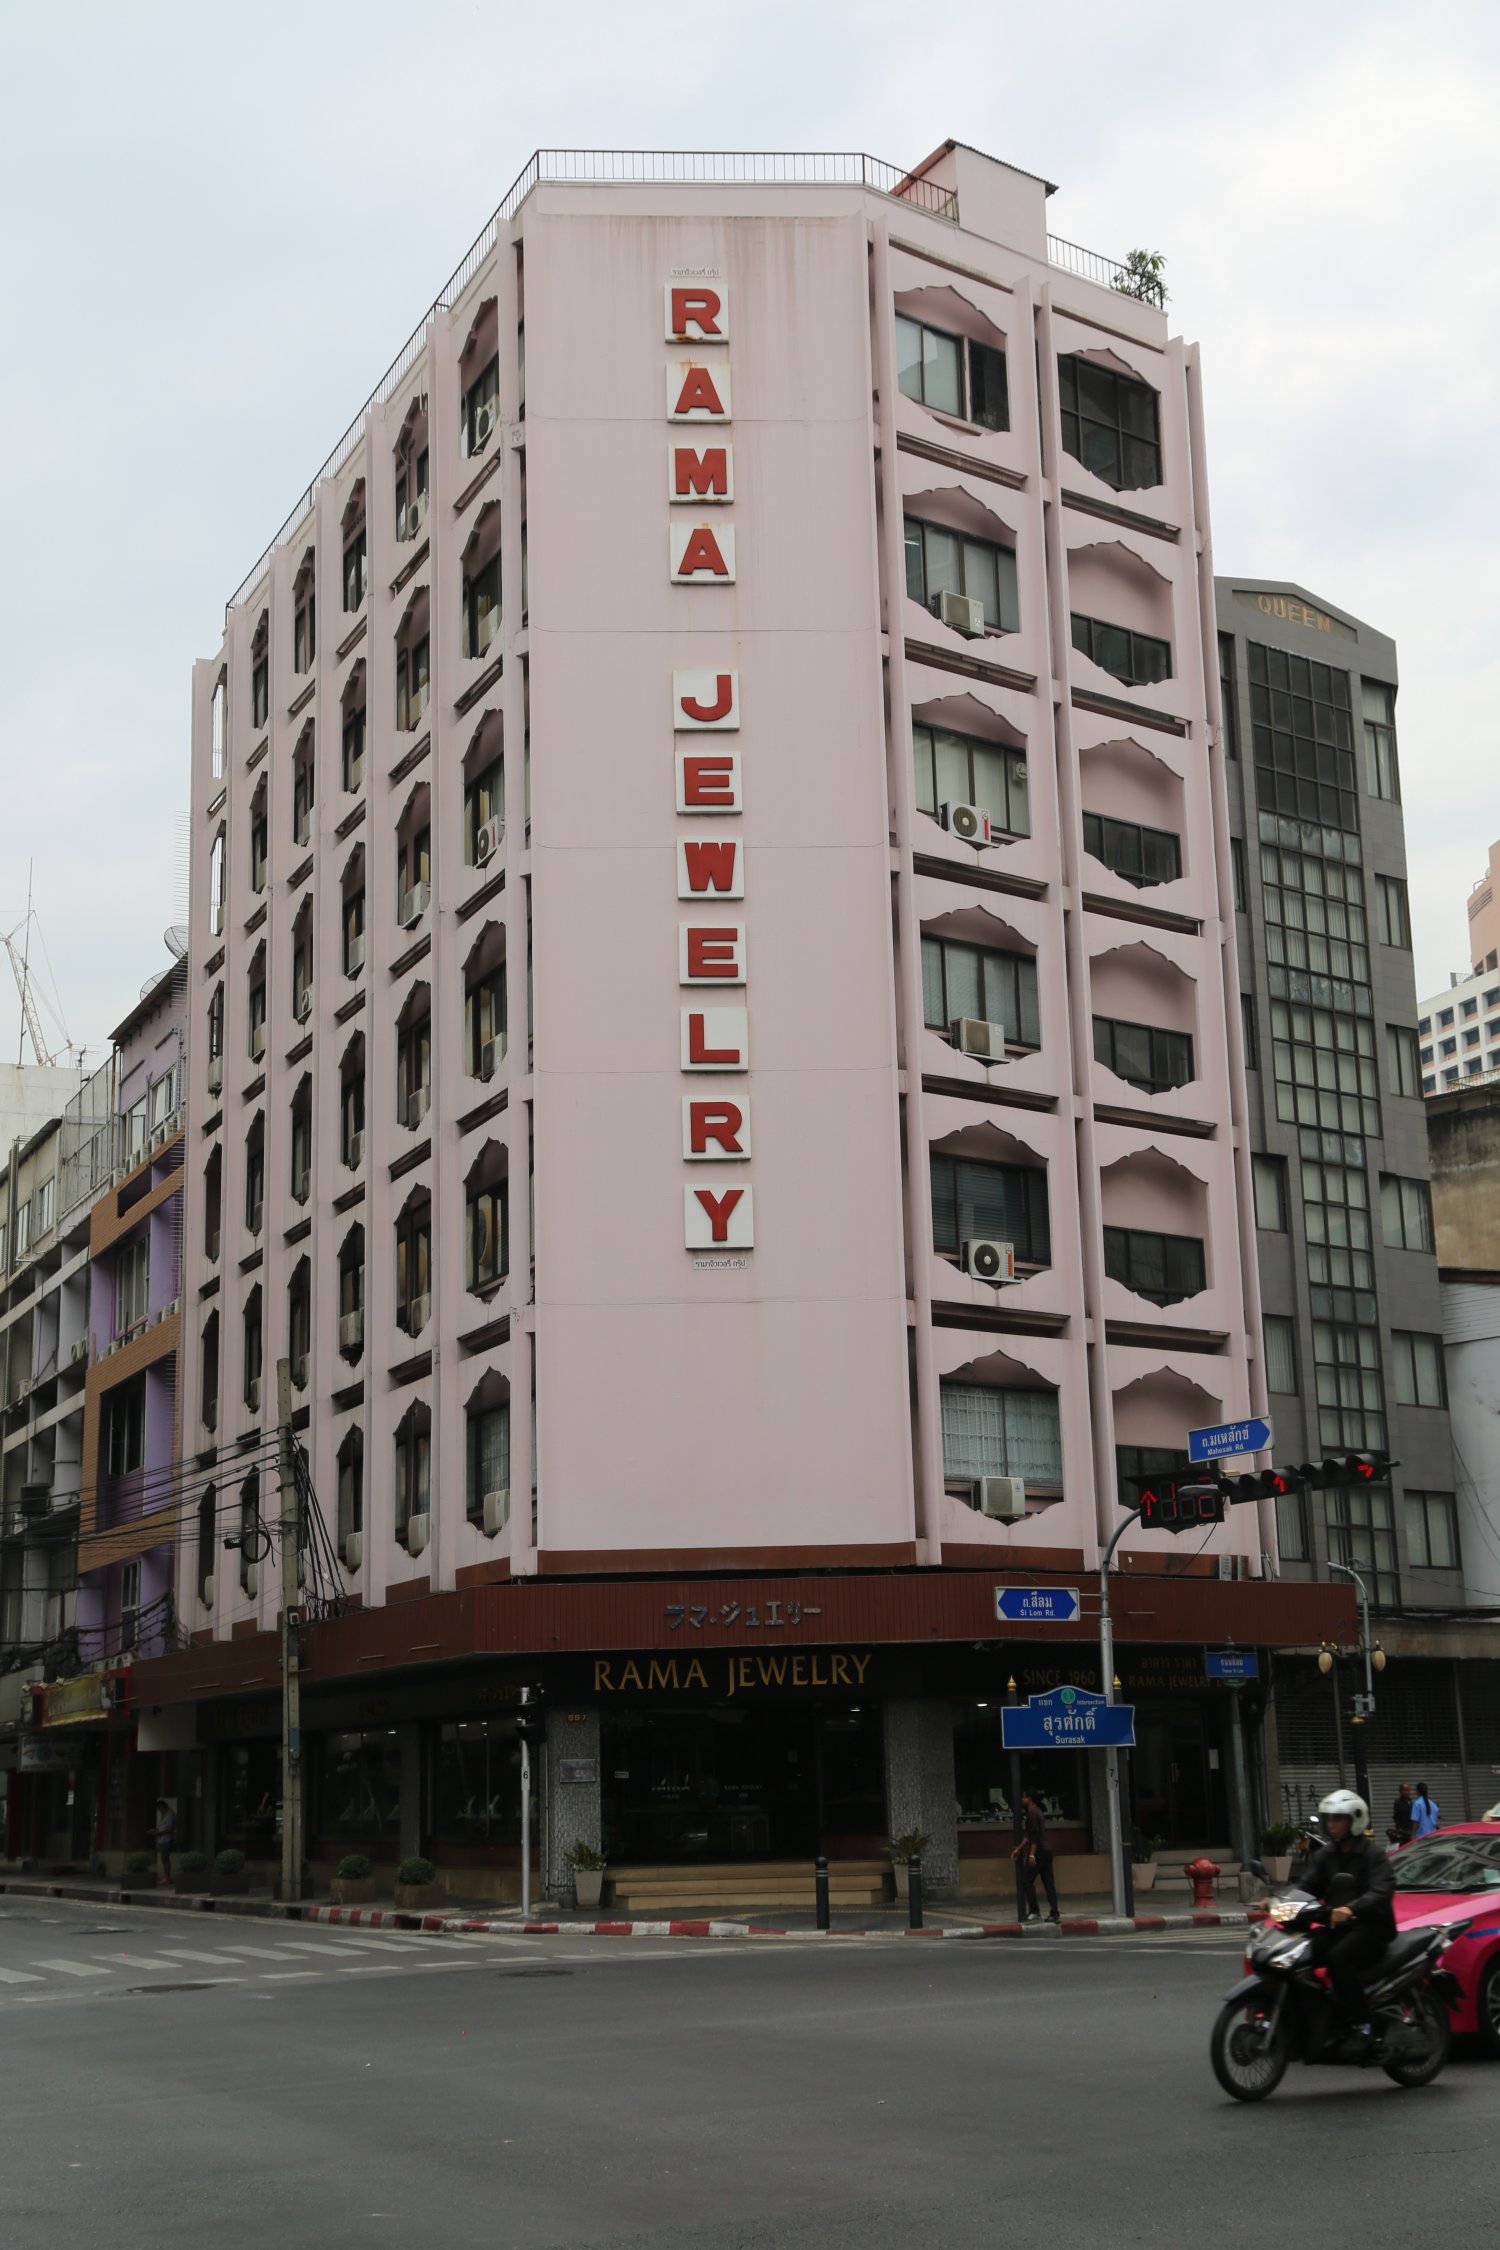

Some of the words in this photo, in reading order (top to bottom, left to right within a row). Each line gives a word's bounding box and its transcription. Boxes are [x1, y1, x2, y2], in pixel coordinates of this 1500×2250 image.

[671, 288, 728, 575] RAMA
[1257, 594, 1331, 633] QUEEN
[680, 674, 744, 1241] JEWELRY
[1207, 1444, 1233, 1456] Mahesak
[1023, 1591, 1052, 1608] ถ.สีลม
[594, 1659, 709, 1691] RAMA
[726, 1654, 872, 1697] JEWELRY
[1023, 1669, 1062, 1686] SINCE
[1068, 1670, 1096, 1686] 1960
[1128, 1675, 1165, 1688] RAMA
[1168, 1674, 1210, 1691] JEWELRY
[1043, 1707, 1097, 1736] สุรศักดิ์
[1055, 1735, 1086, 1744] Surasak
[523, 1770, 528, 1780] 6
[1109, 1768, 1114, 1777] 7
